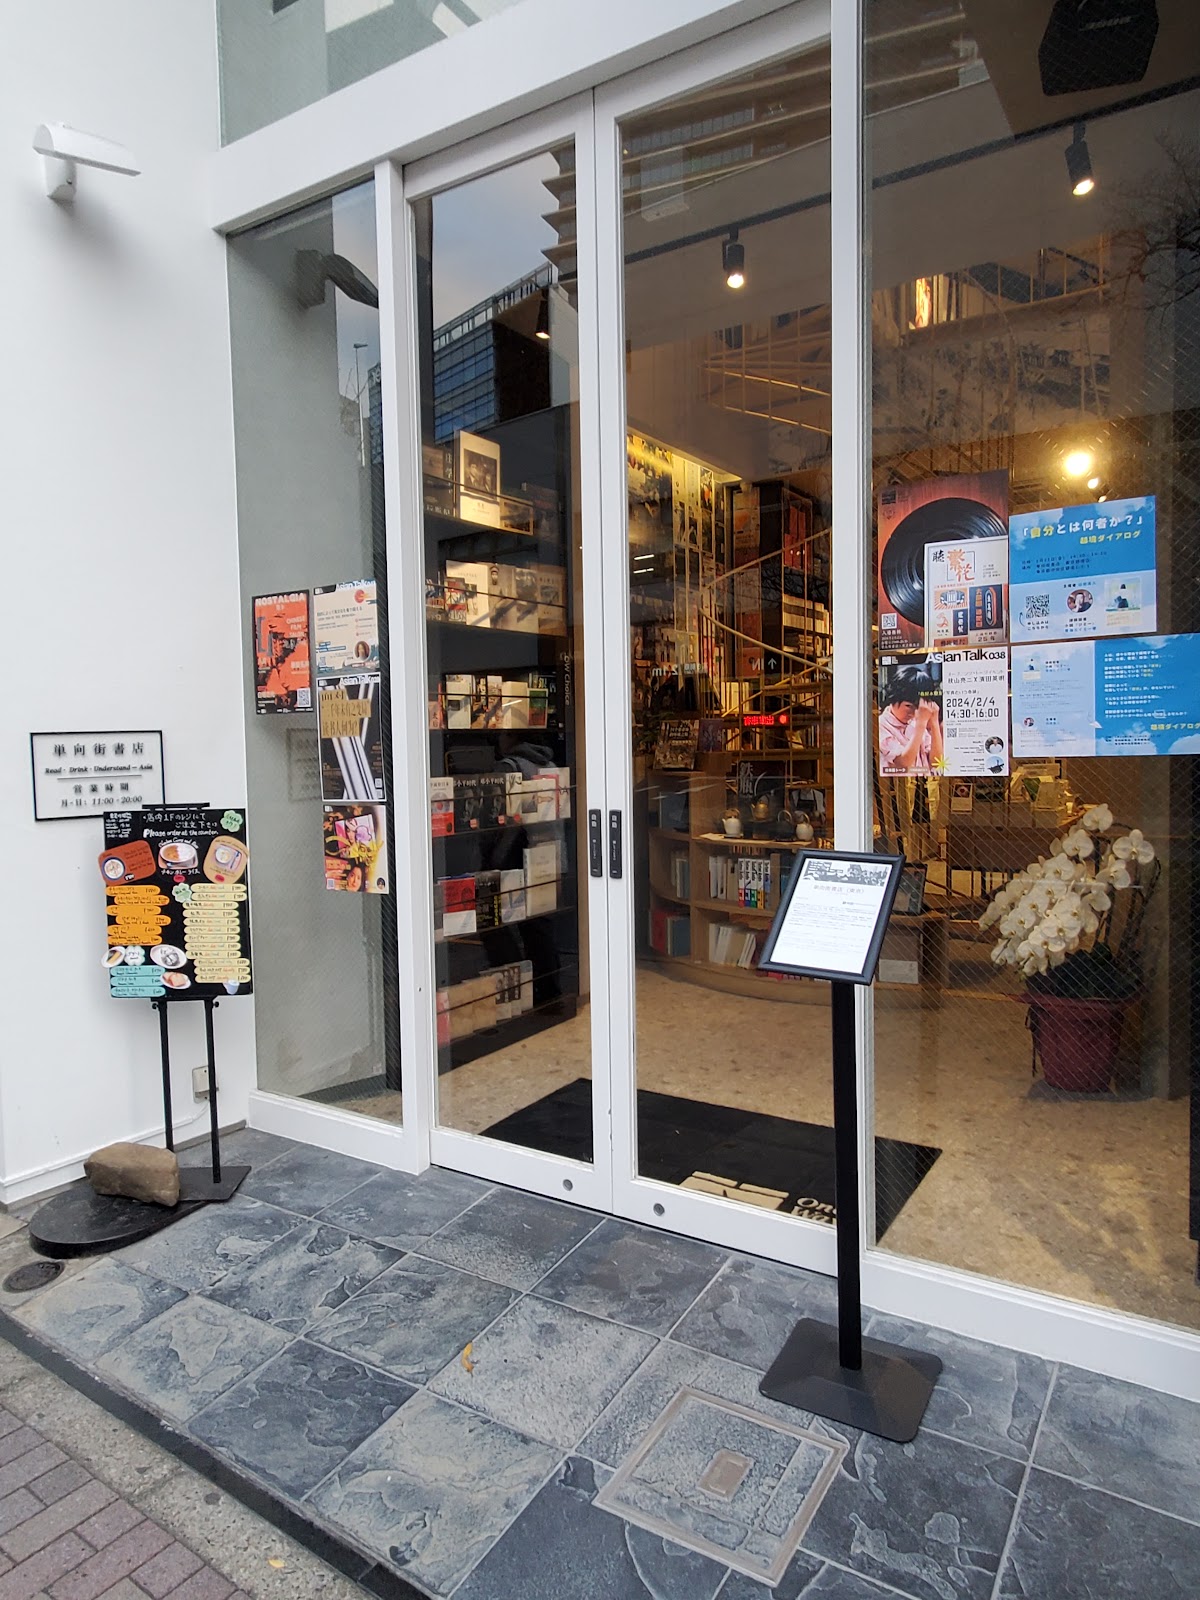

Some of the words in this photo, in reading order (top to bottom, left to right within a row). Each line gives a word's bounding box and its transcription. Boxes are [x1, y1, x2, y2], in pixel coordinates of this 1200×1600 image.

[925, 651, 961, 664] Asian
[962, 648, 988, 661] Talk
[988, 650, 1006, 660] 038
[946, 696, 995, 708] 2024/2/4
[946, 708, 999, 719] 14:30-16:00
[69, 765, 88, 773] Drink
[94, 764, 130, 772] Understand
[120, 795, 143, 804] 20:00
[143, 828, 166, 838] Please
[797, 1197, 837, 1215] On
